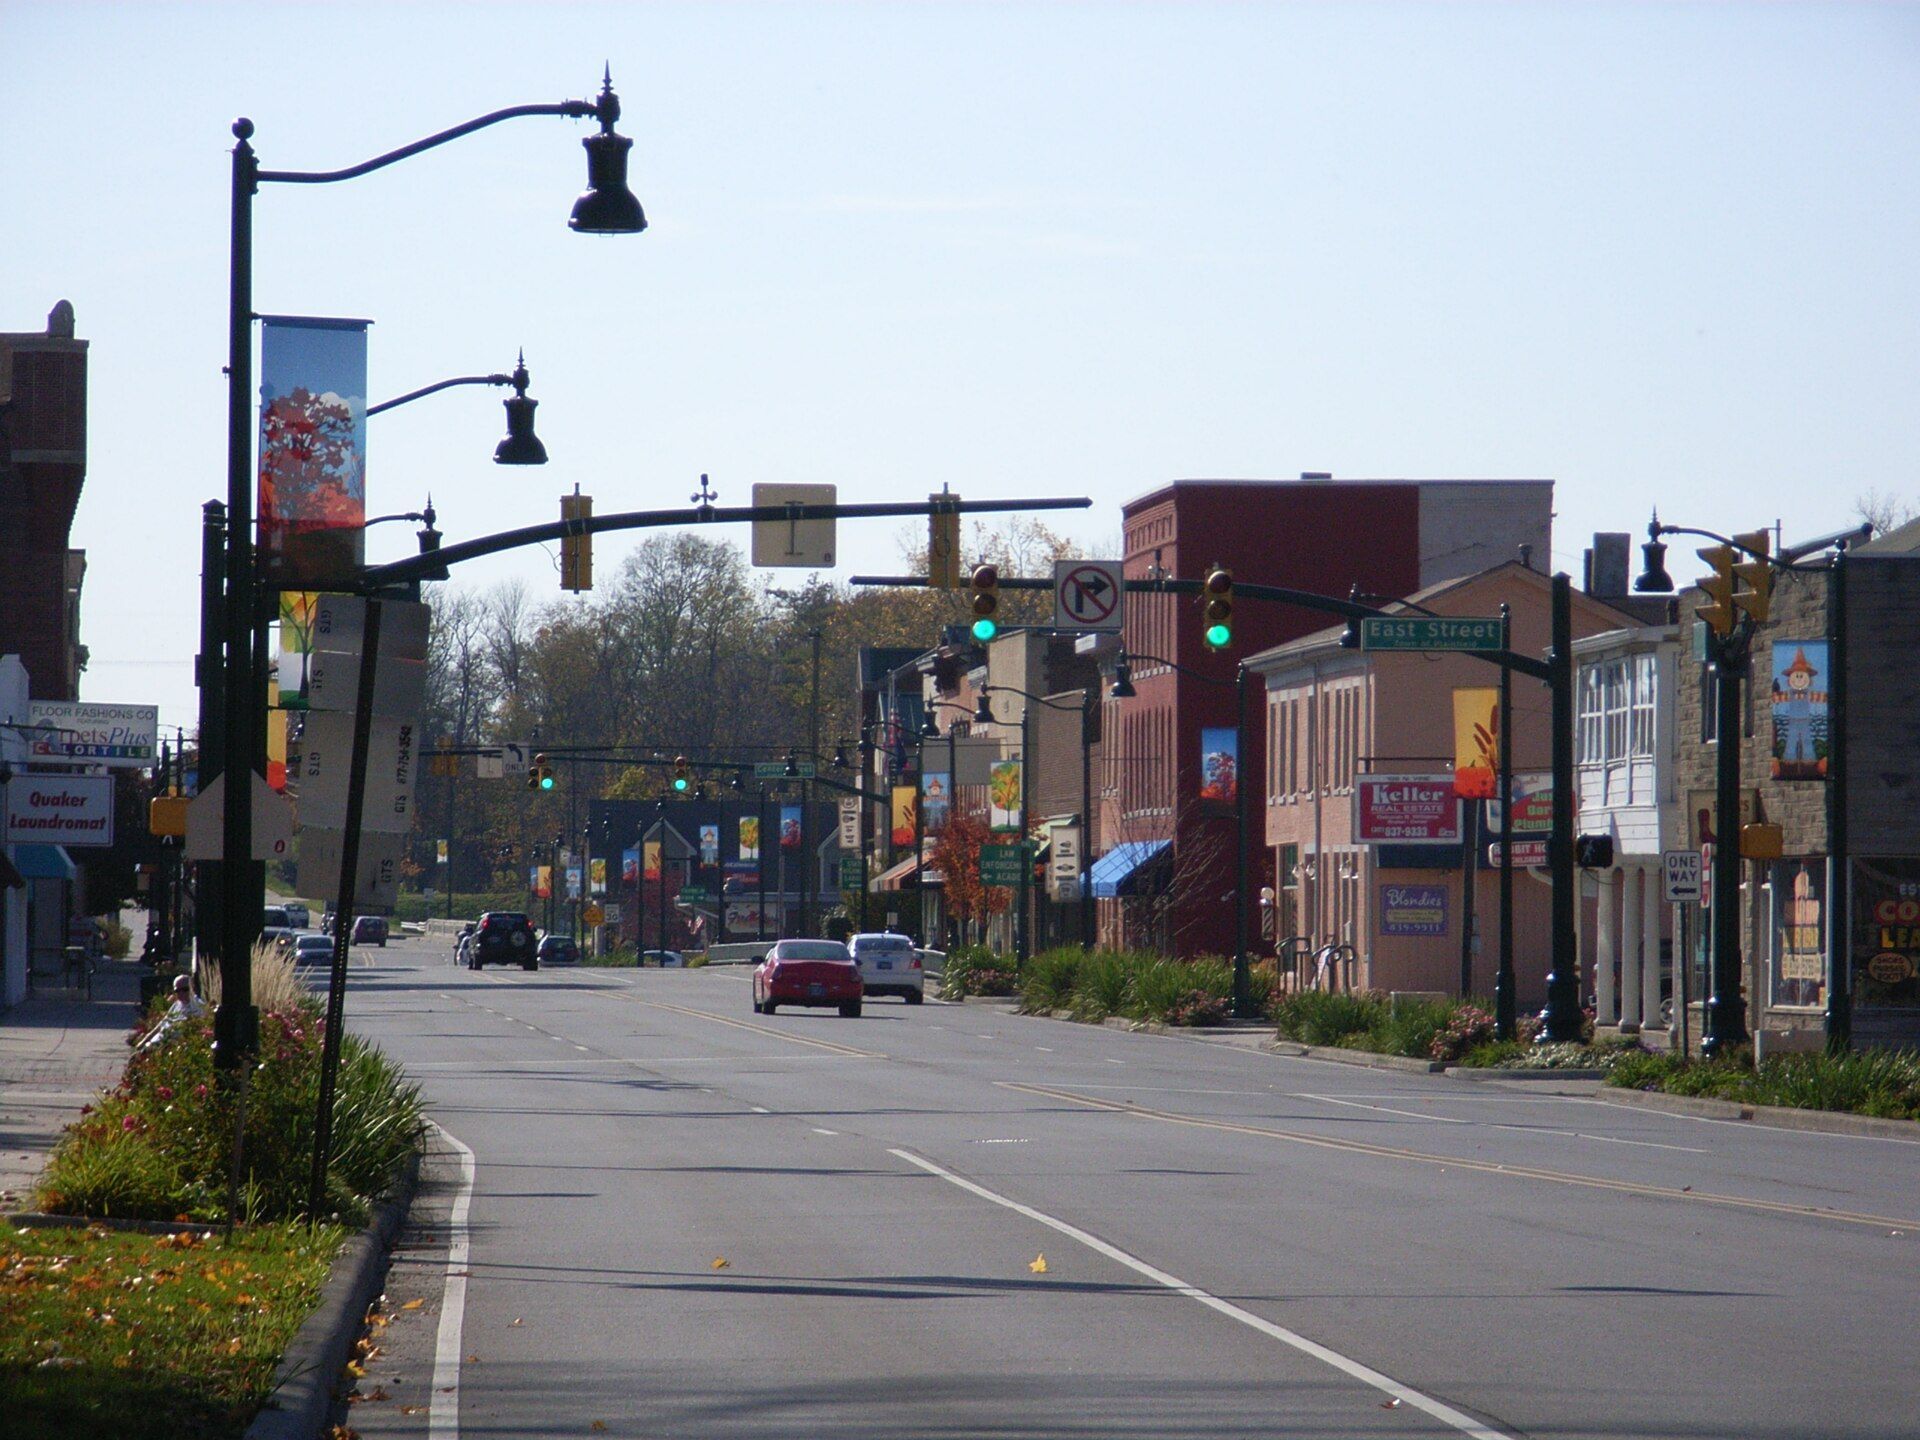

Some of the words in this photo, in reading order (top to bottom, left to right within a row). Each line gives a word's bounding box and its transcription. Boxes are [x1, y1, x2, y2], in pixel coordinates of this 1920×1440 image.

[320, 609, 333, 634] GTS
[1370, 621, 1416, 637] East
[1428, 621, 1495, 638] Street
[32, 705, 72, 717] FLOOR
[75, 707, 134, 720] FASHIONS
[136, 710, 154, 721] CO
[37, 743, 149, 757] CLORTILE
[308, 751, 321, 777] GTS
[505, 764, 526, 772] ONLY
[29, 790, 88, 808] Quaker
[1372, 784, 1444, 804] Keller
[394, 794, 407, 814] GTS
[1403, 805, 1444, 813] ESTATE
[9, 813, 106, 830] Laundromat
[1669, 856, 1697, 868] ONE
[1669, 870, 1697, 882] WAY
